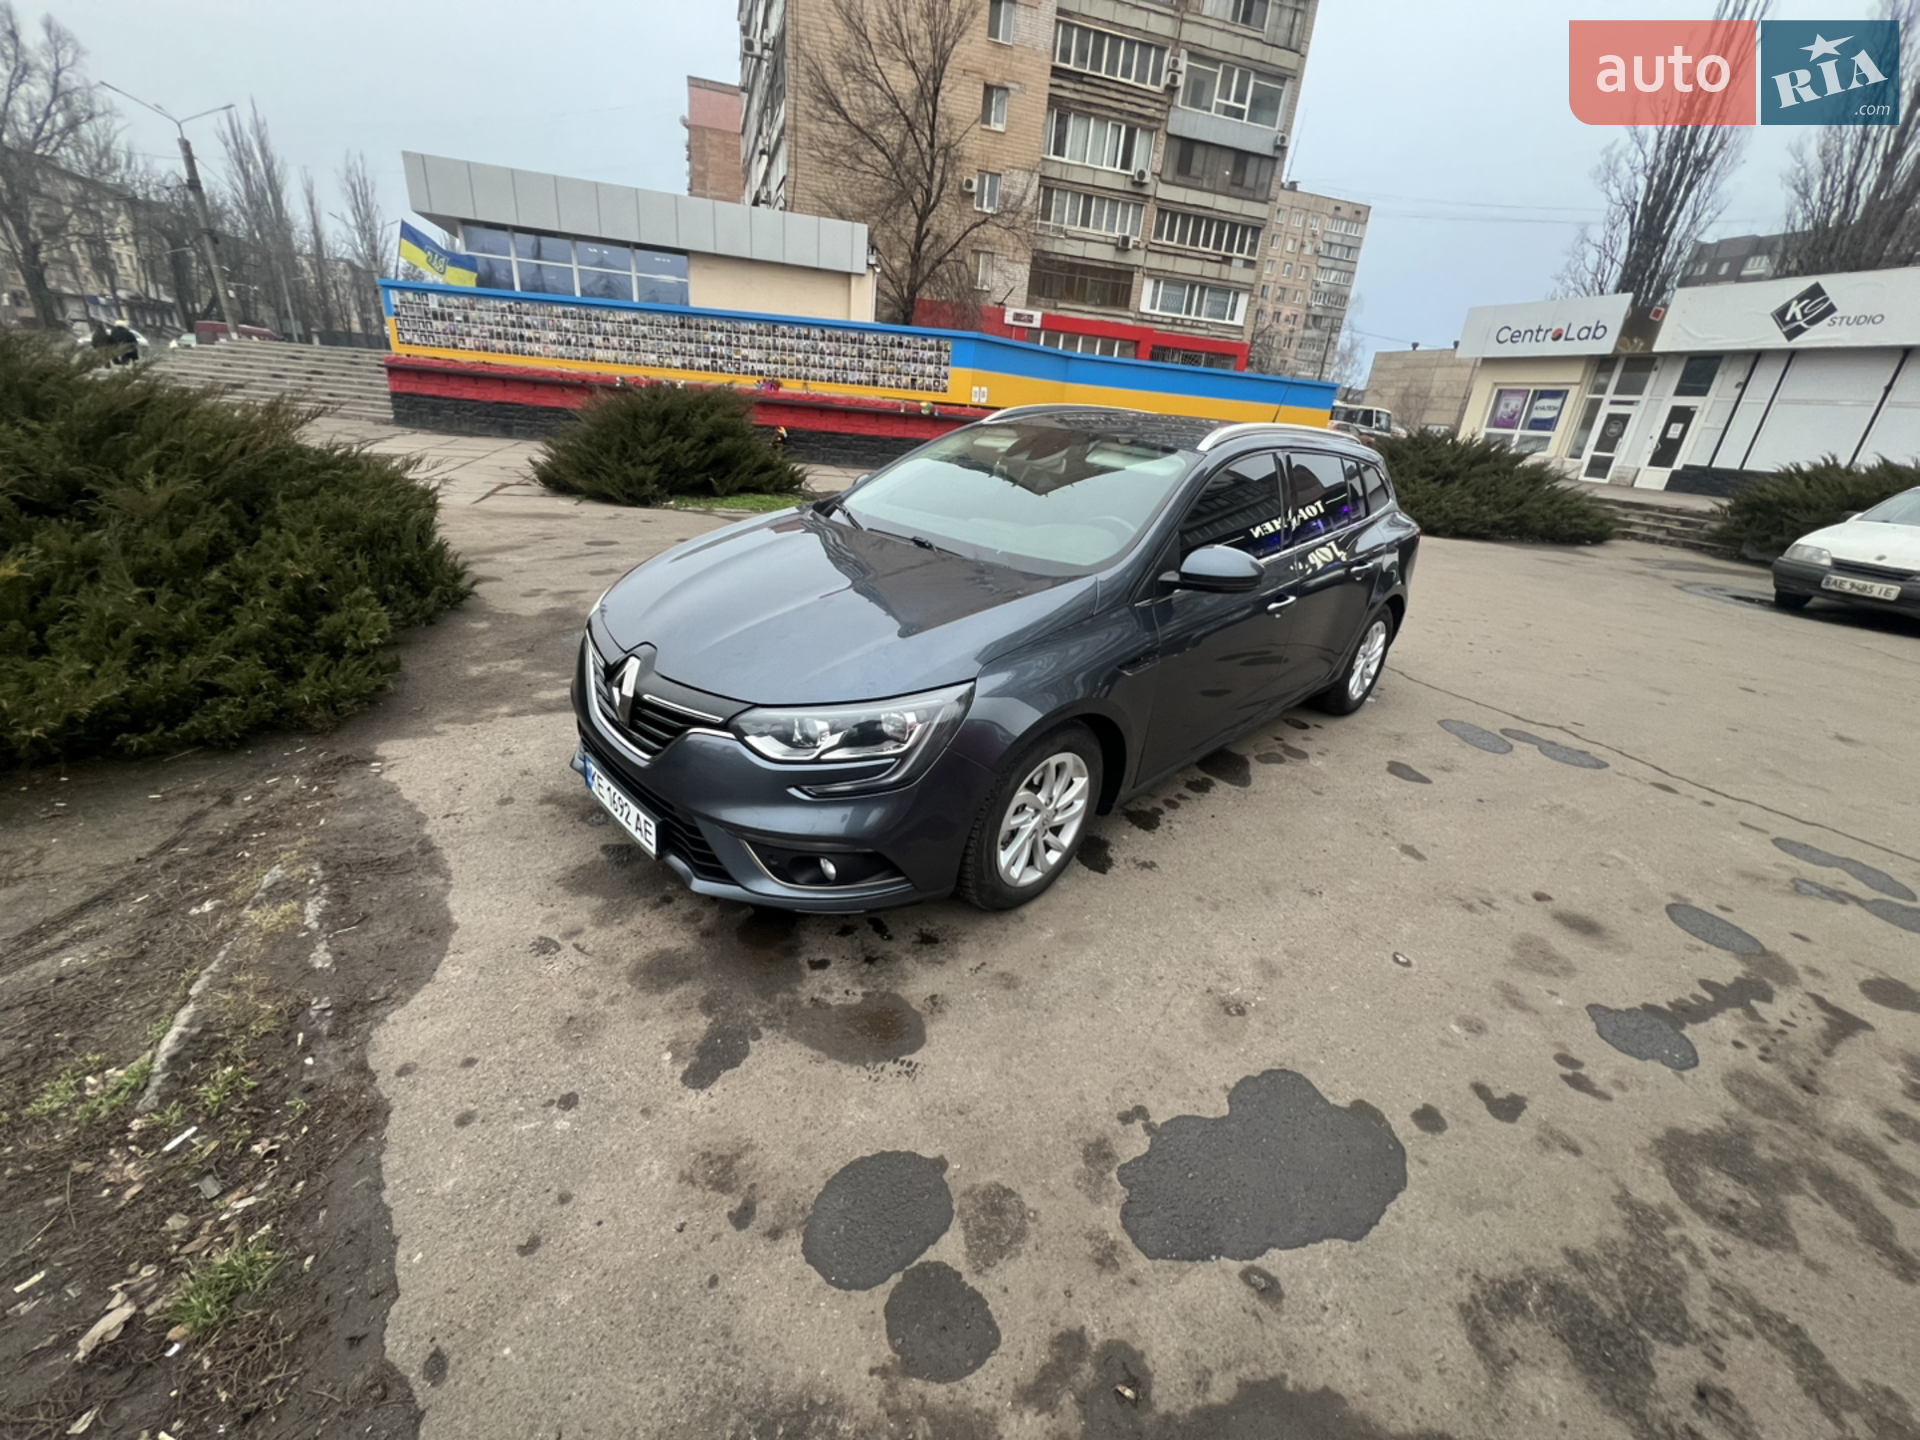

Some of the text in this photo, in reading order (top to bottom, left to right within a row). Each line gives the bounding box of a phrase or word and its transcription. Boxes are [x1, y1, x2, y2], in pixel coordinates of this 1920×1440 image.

[1495, 320, 1608, 345] CentroLab
[1827, 313, 1885, 327] STUDIO
[635, 812, 654, 848] AE
